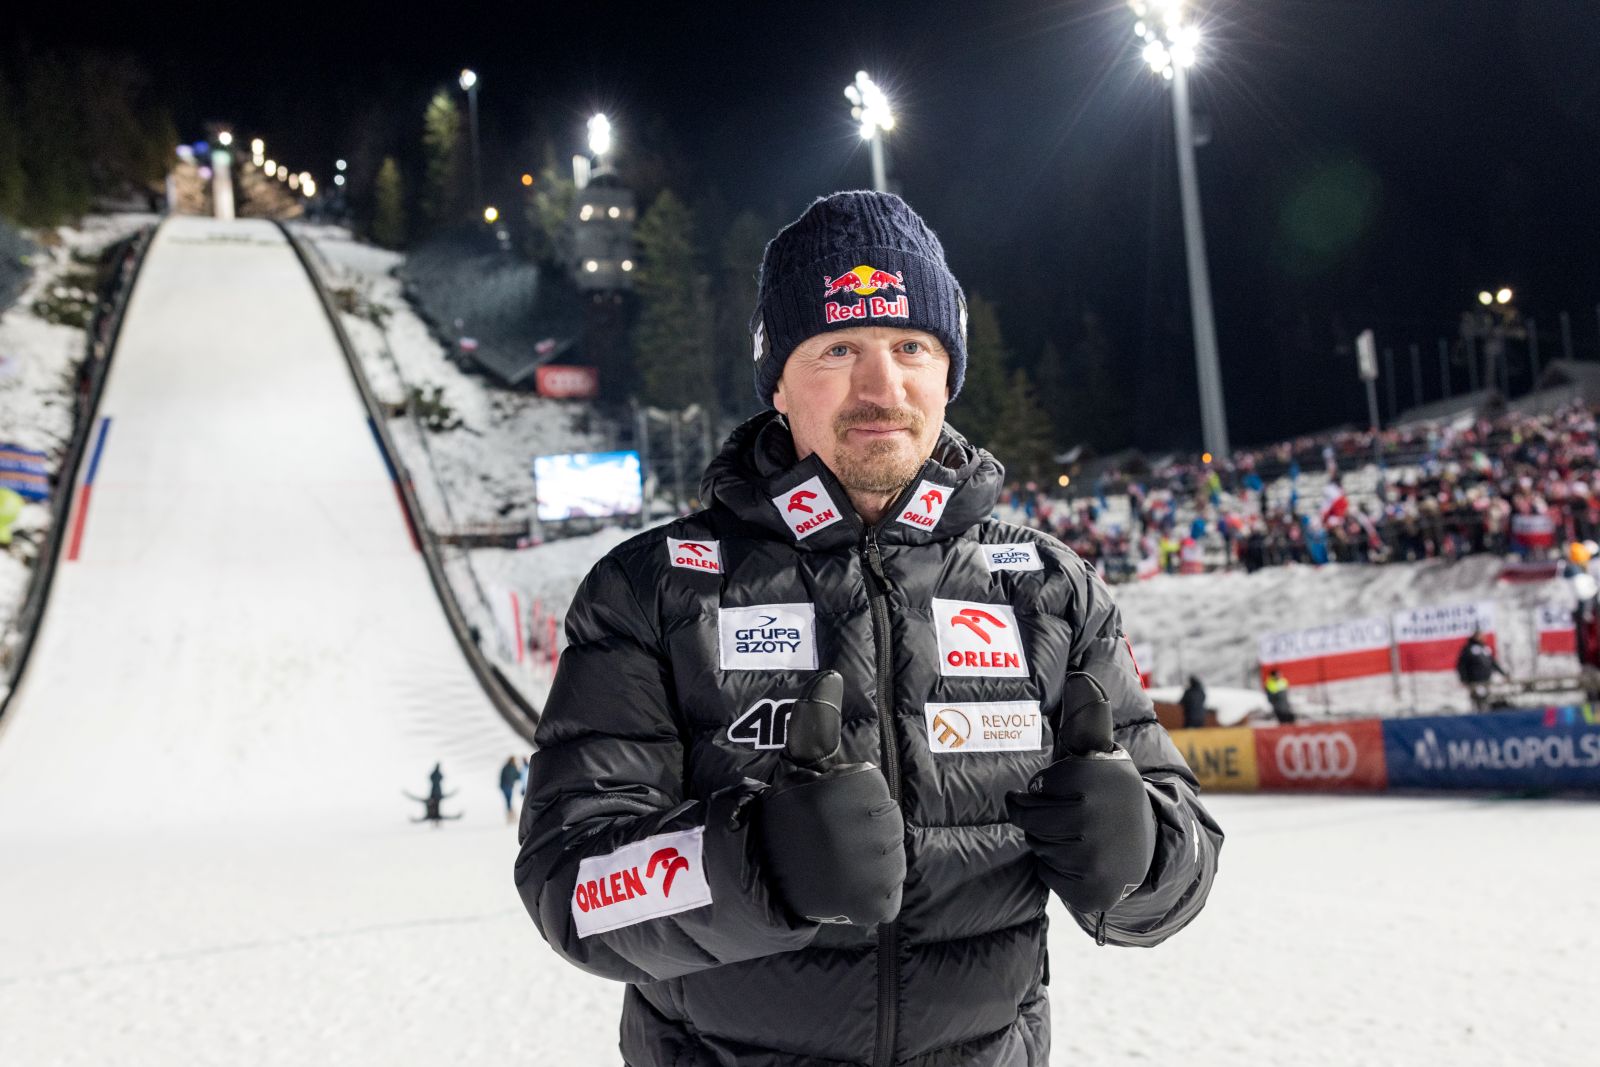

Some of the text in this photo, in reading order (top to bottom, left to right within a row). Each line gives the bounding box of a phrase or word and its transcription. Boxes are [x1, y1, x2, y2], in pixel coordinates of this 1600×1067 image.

[825, 295, 910, 323] Red Bull
[795, 509, 835, 534] ORLEN
[903, 511, 936, 527] ORLEN
[676, 557, 719, 570] ORLEN
[947, 650, 1020, 668] ORLEN
[981, 714, 1037, 728] REVOLT
[983, 730, 1022, 740] ENERGY
[575, 866, 647, 913] ORLEN
